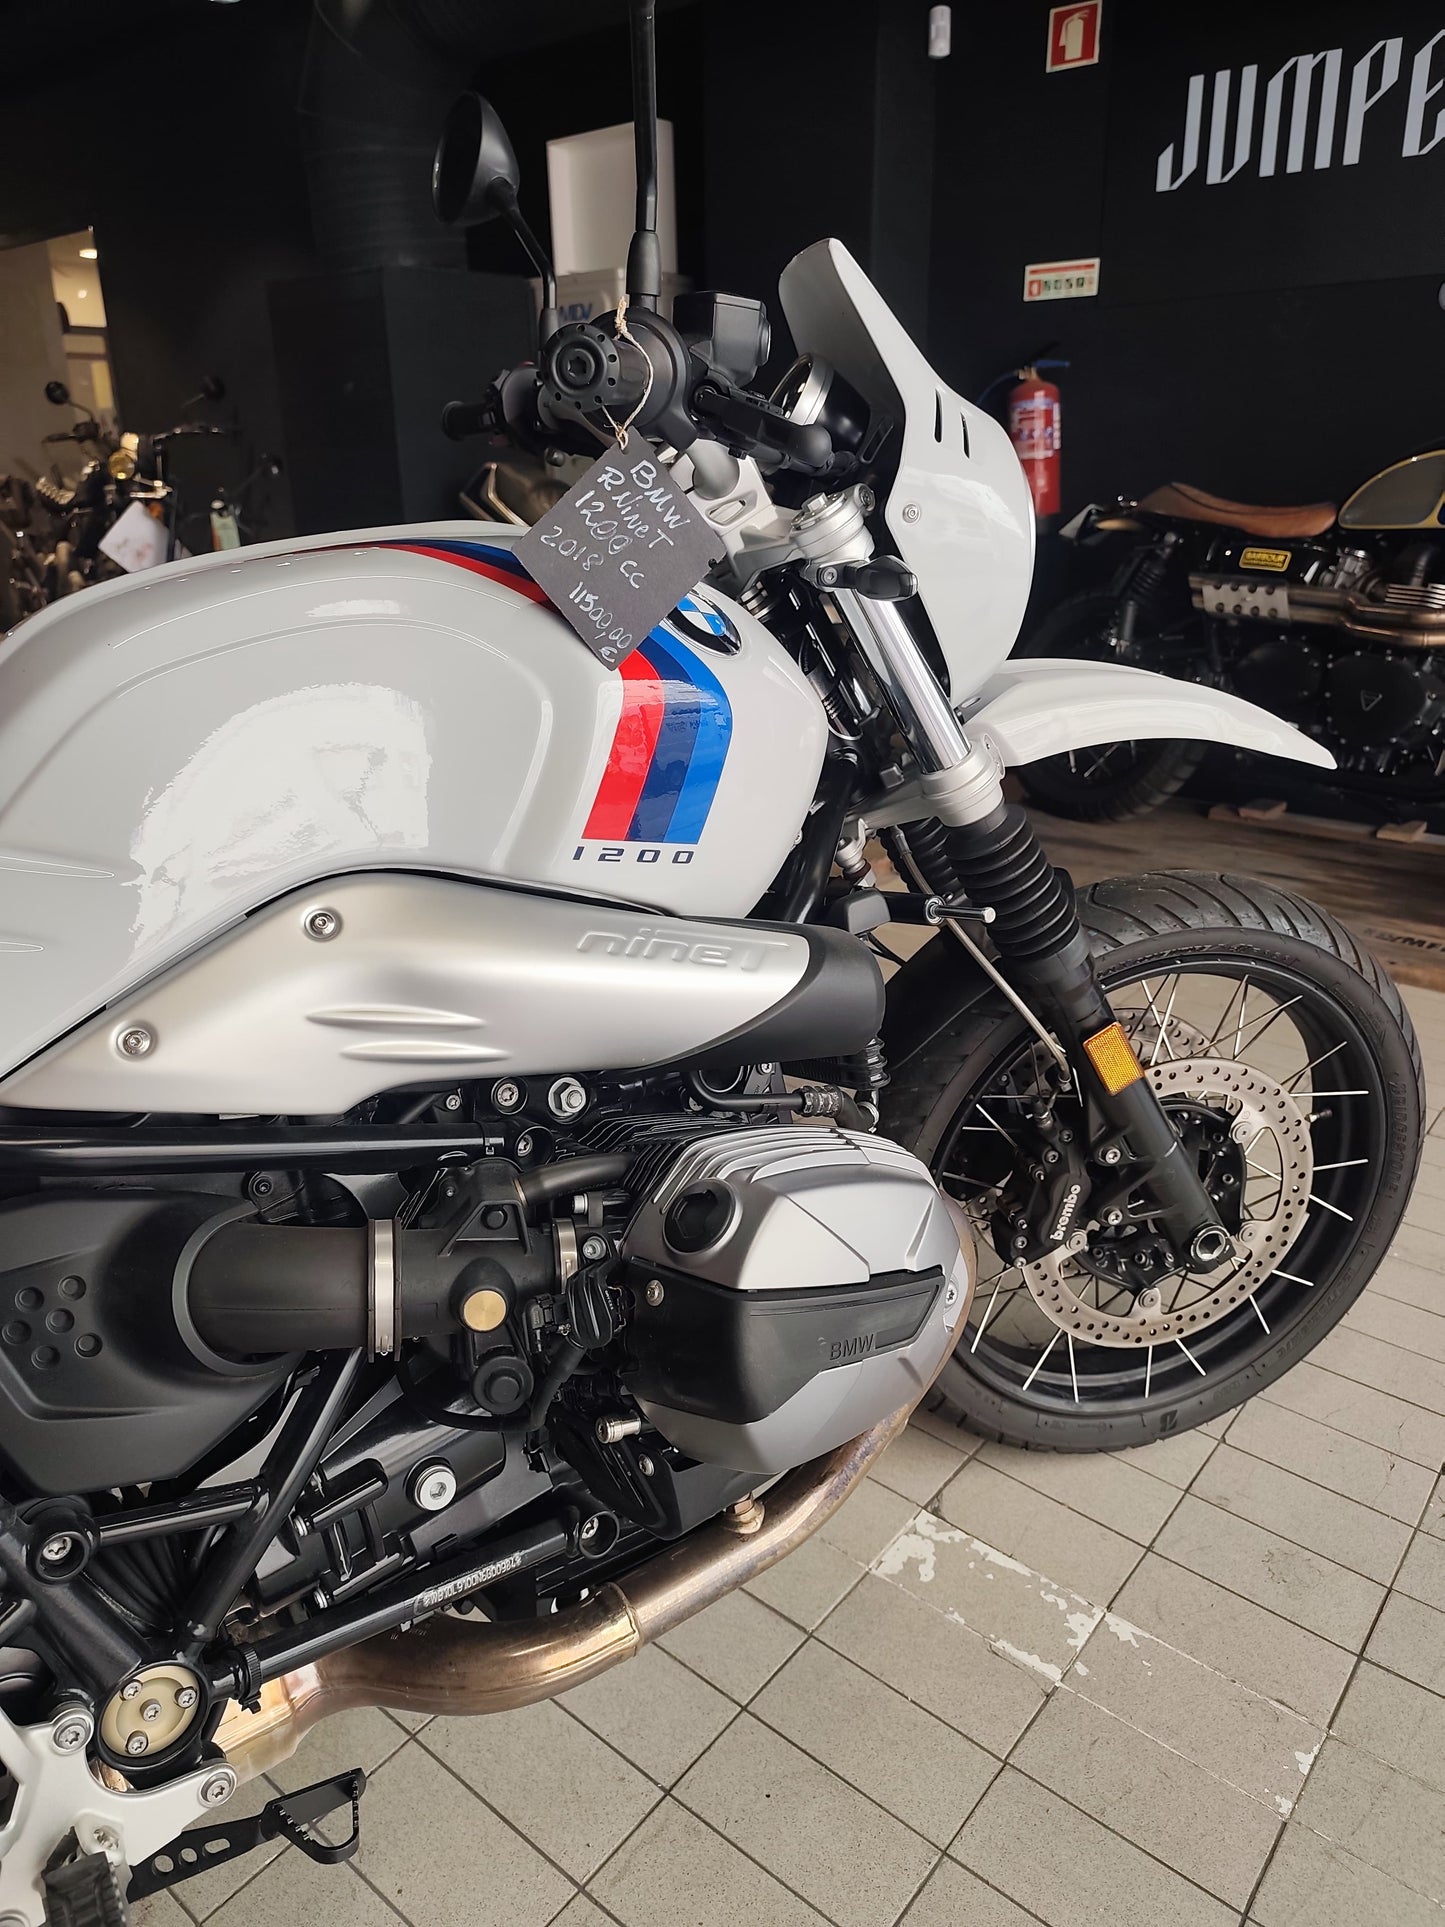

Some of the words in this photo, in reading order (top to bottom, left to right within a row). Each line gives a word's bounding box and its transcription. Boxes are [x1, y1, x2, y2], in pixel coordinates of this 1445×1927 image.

[596, 465, 626, 491] R
[629, 459, 691, 529] BMW
[575, 490, 633, 555] 1200
[540, 525, 604, 571] 2018
[572, 845, 695, 865] 1200
[1049, 1184, 1081, 1241] brembo
[829, 1333, 874, 1361] BMW
